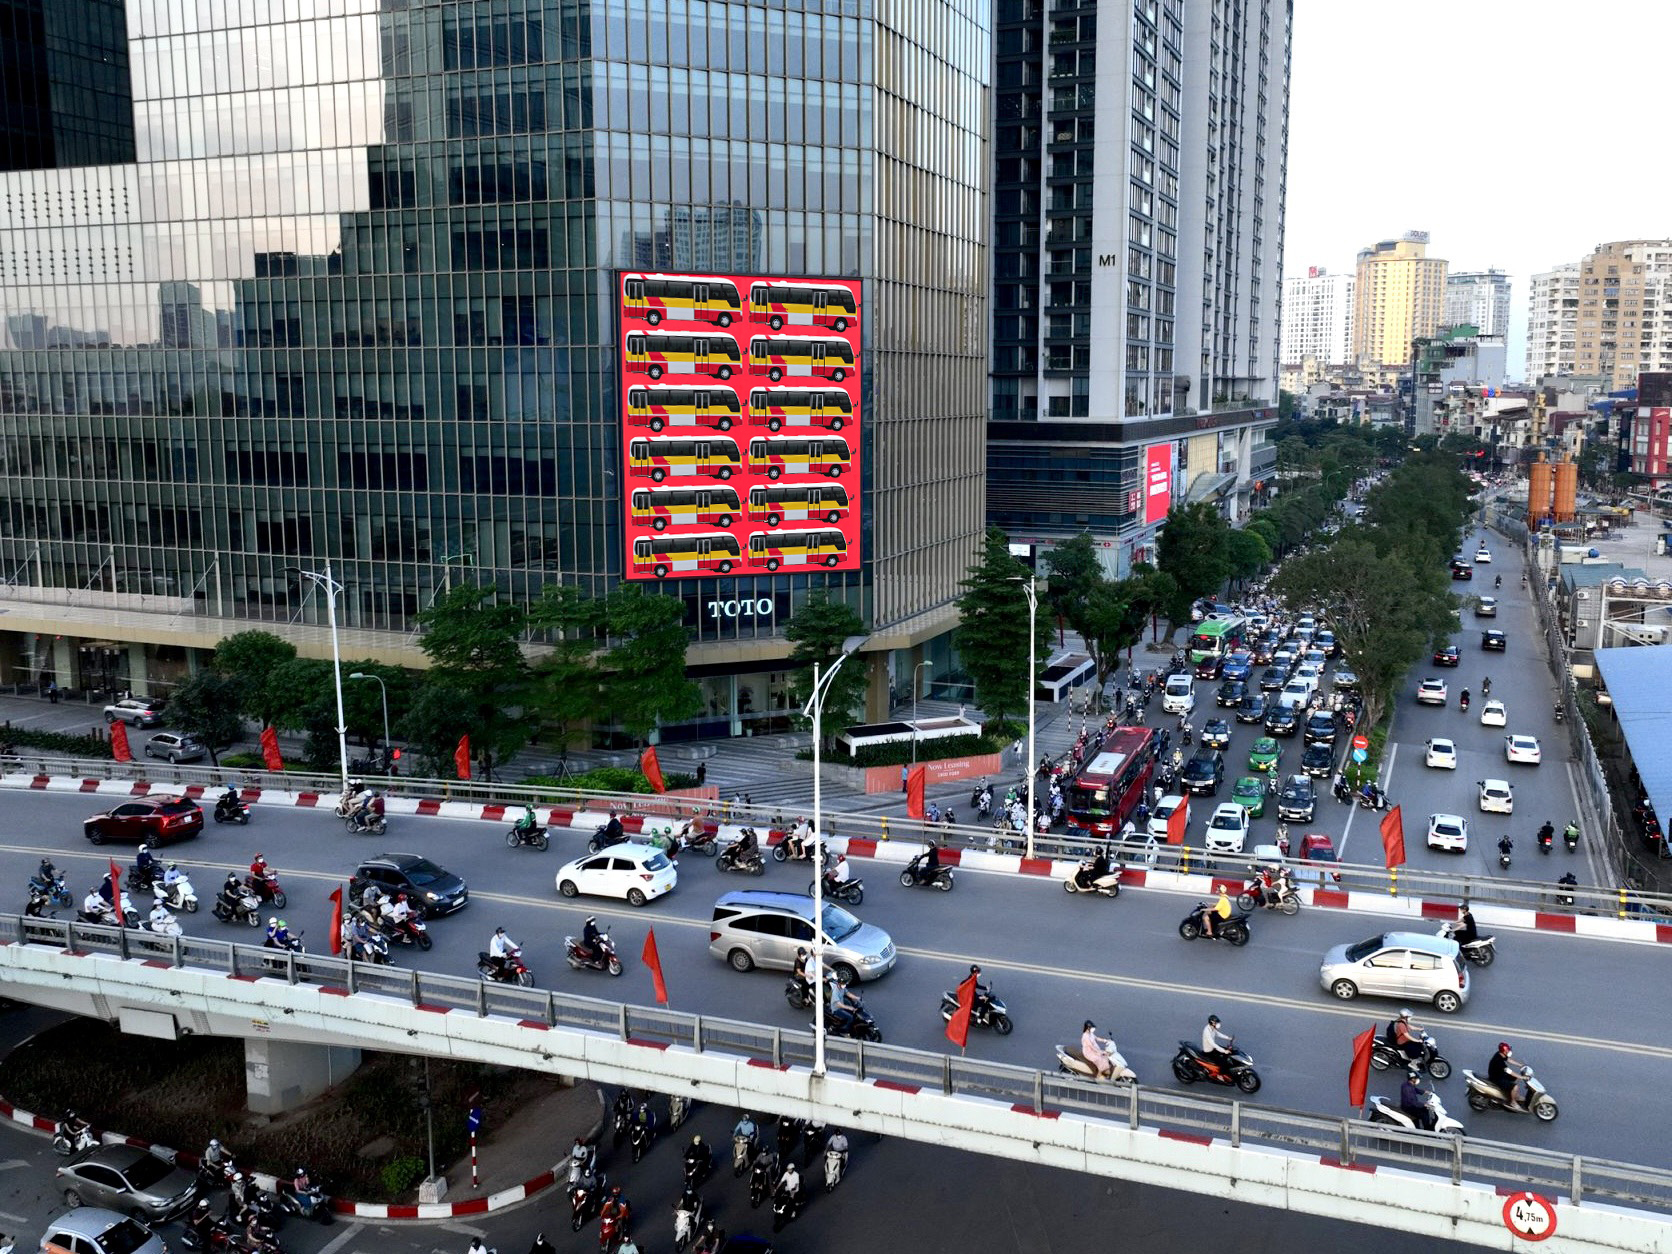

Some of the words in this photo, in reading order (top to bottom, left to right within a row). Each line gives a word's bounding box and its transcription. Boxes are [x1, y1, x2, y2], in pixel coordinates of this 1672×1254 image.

[1099, 254, 1116, 267] M1
[708, 598, 773, 618] TOTO
[927, 763, 943, 771] Now
[943, 760, 970, 770] Leasing
[1516, 1206, 1544, 1223] 4,75m
